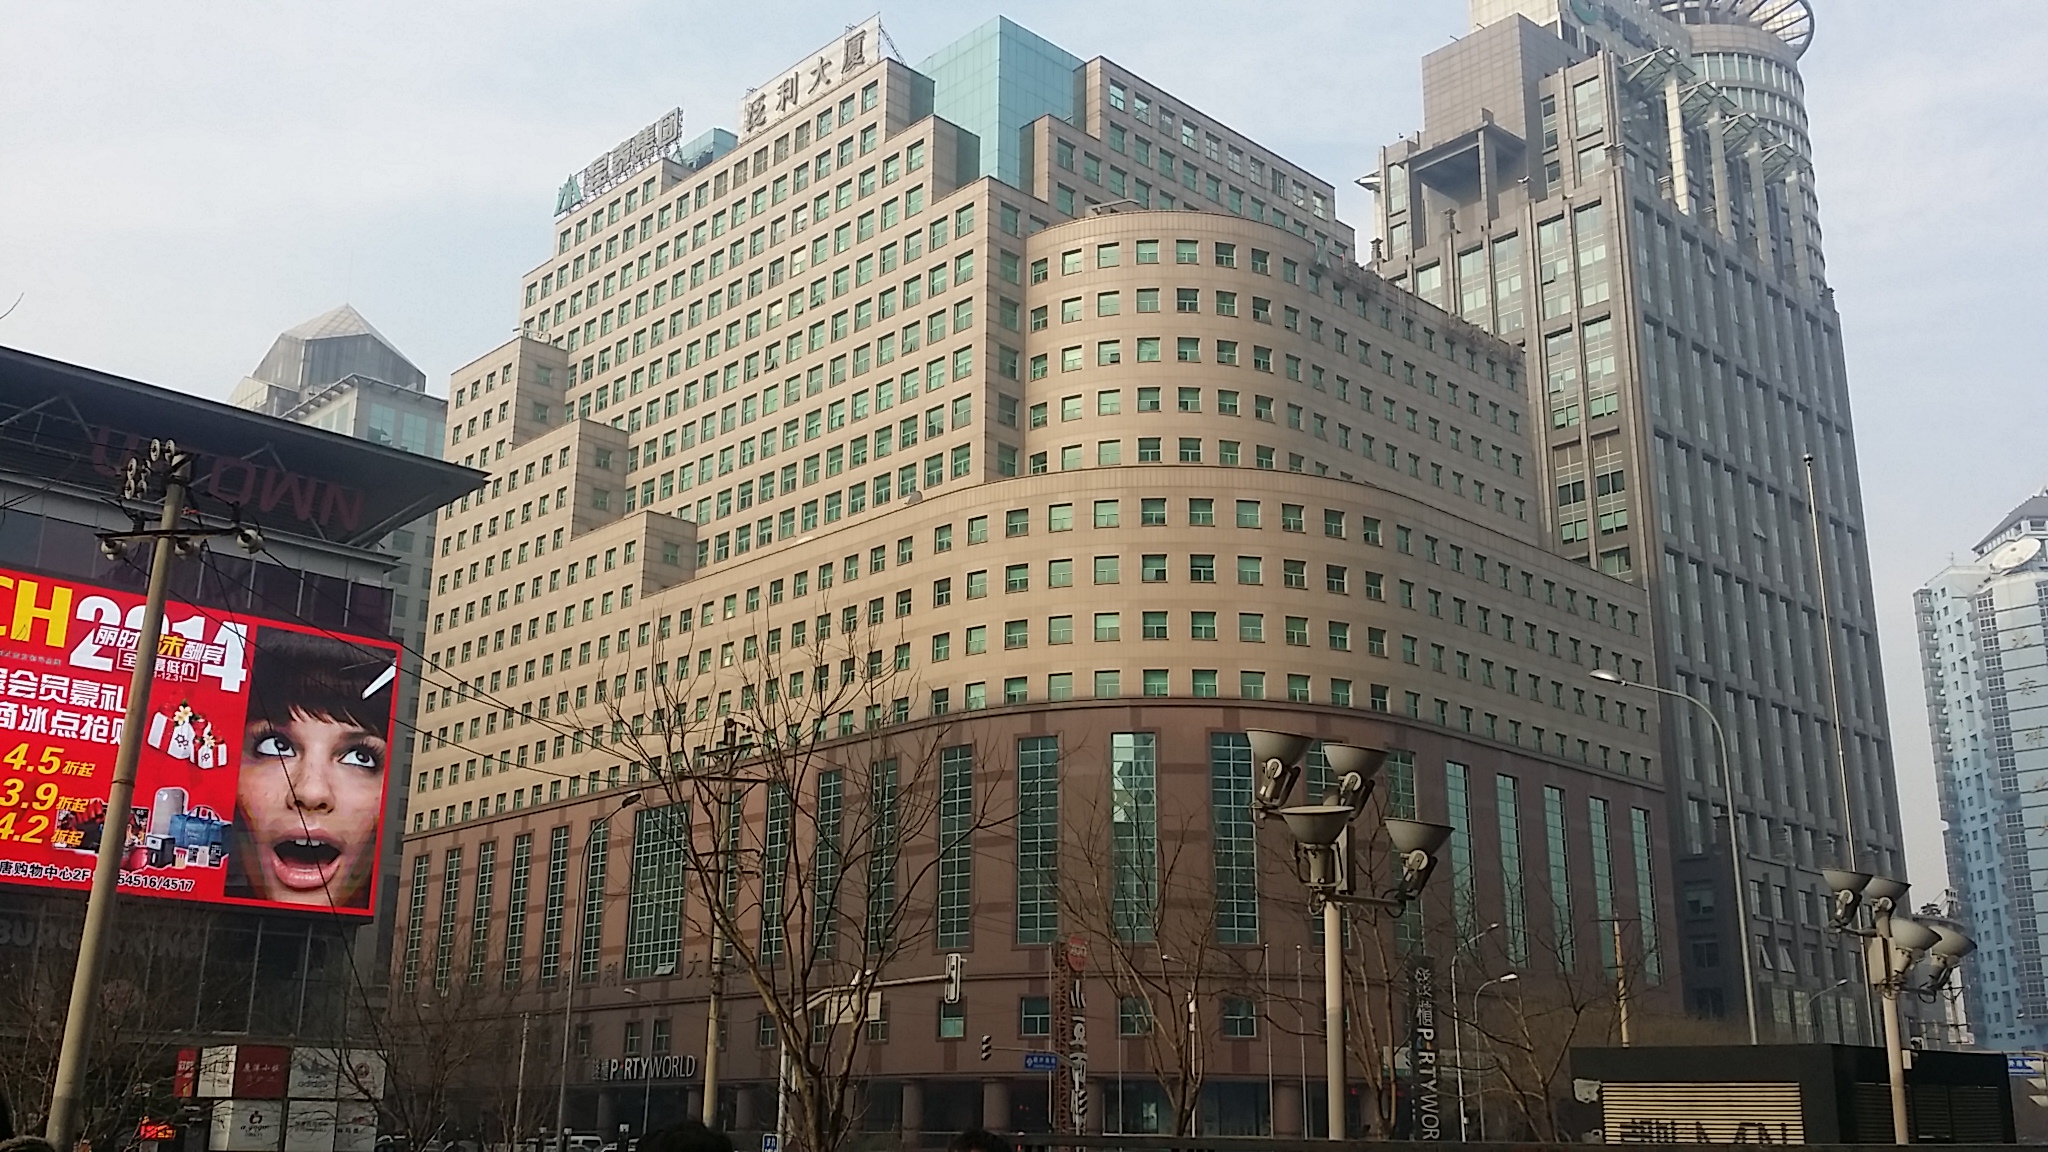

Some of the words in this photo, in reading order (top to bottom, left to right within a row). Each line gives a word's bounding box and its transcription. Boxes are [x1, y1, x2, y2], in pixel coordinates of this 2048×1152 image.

[94, 625, 226, 666] 丽时末酬宾
[122, 652, 195, 678] 全最低价
[0, 667, 127, 714] 会员豪礼
